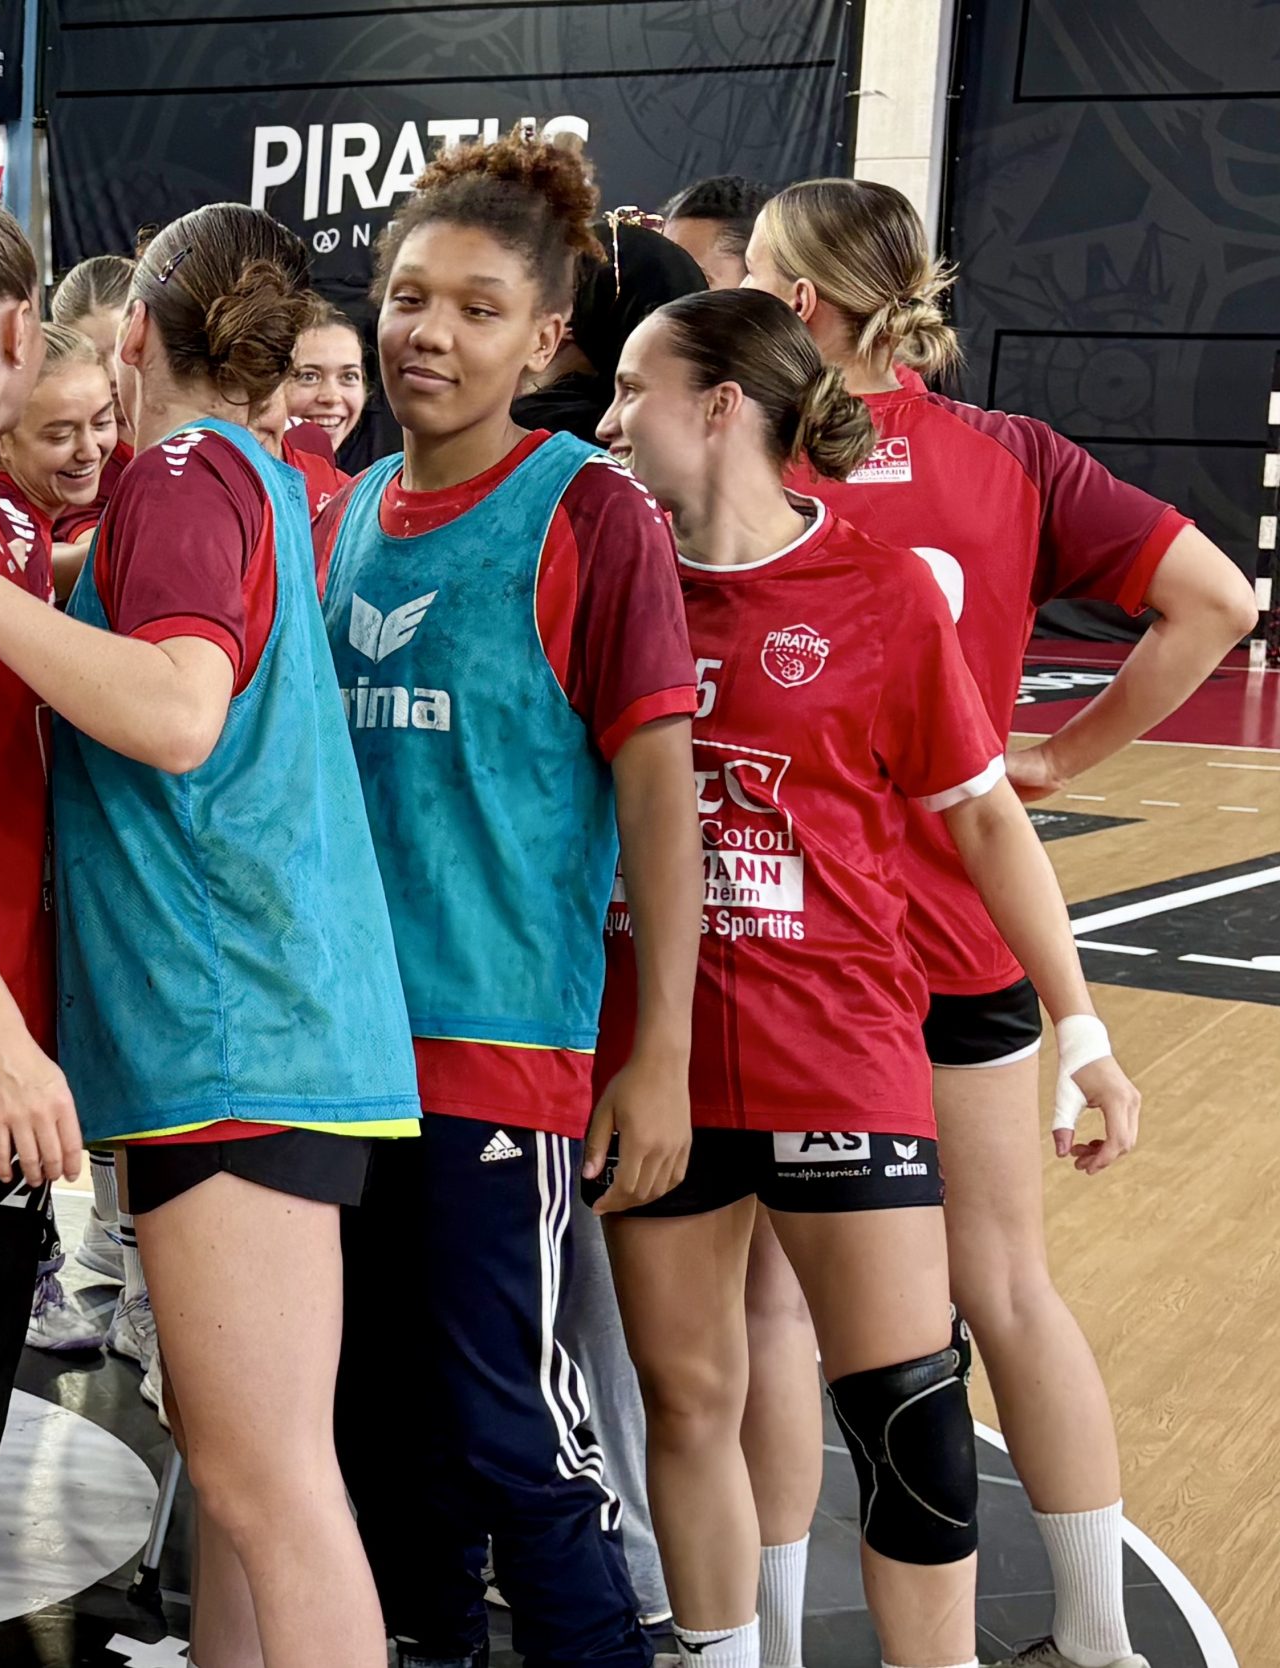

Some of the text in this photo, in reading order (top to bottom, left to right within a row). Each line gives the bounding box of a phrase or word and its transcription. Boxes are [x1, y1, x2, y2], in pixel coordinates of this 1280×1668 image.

[251, 114, 590, 221] PIRAT
[763, 631, 831, 658] PIRATHS
[340, 676, 451, 732] rima
[699, 818, 795, 851] Coton
[715, 909, 806, 941] Sportifs
[777, 1165, 872, 1182] www.alpha-service.fr
[884, 1161, 928, 1178] erima
